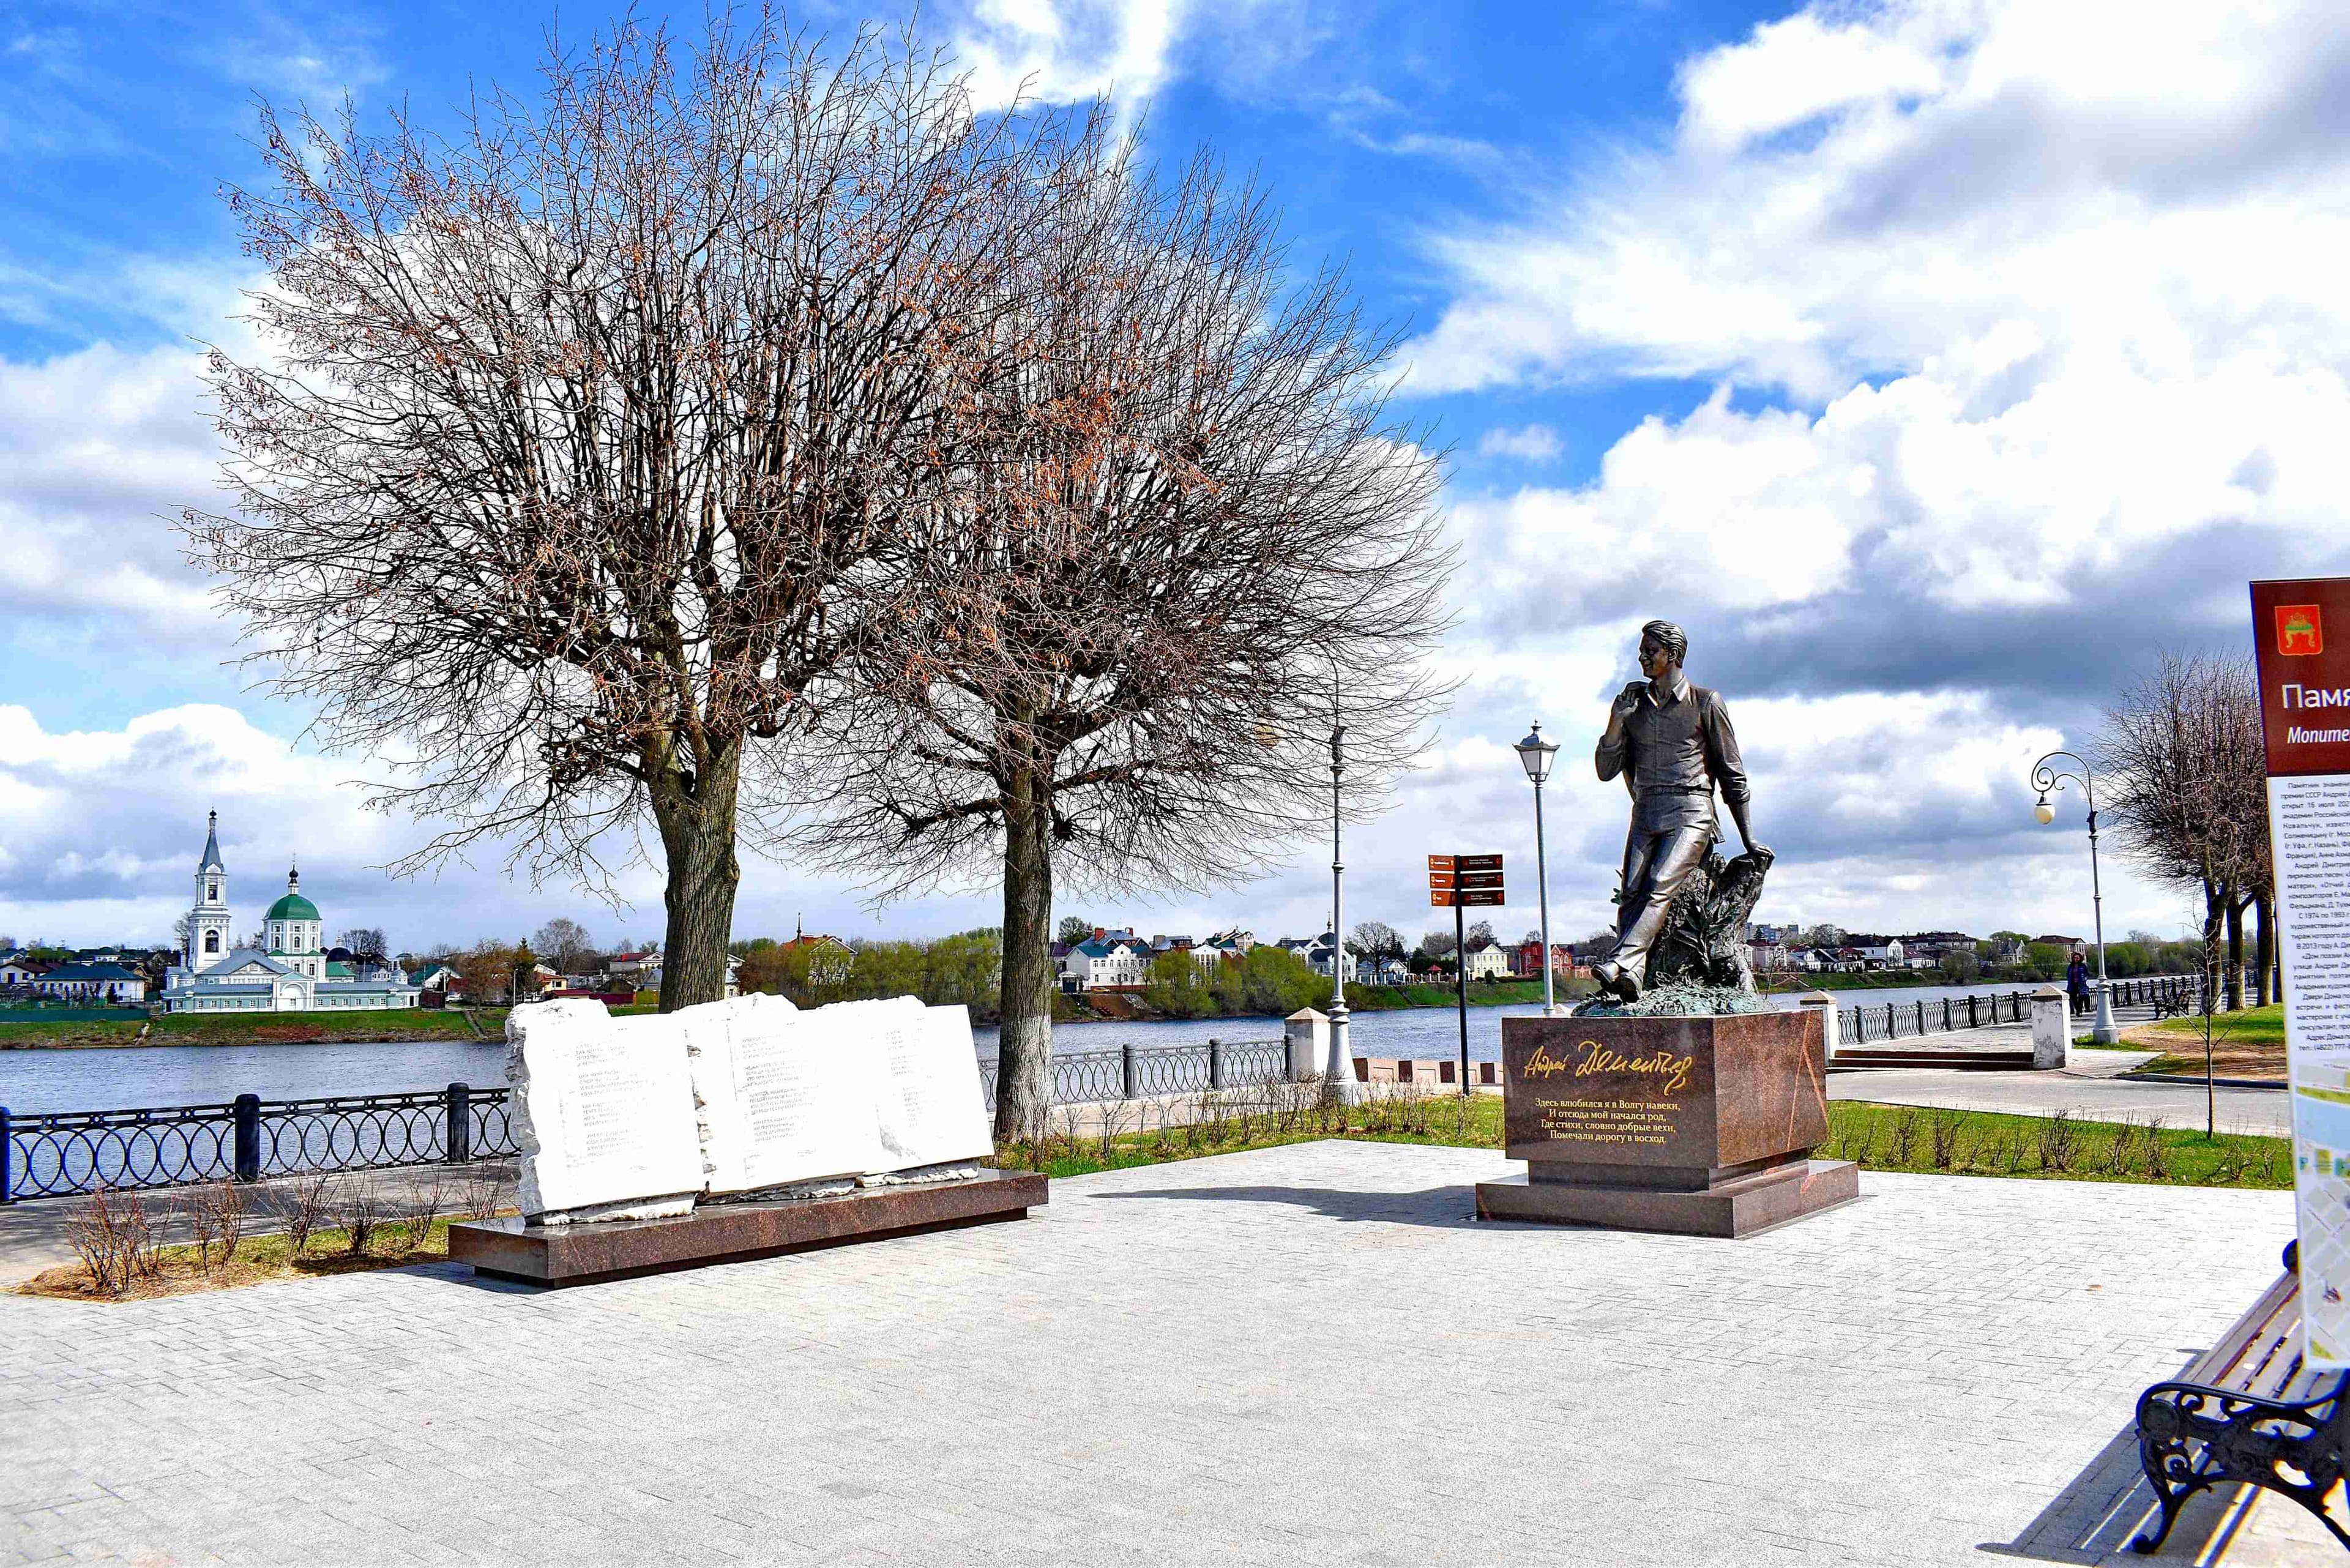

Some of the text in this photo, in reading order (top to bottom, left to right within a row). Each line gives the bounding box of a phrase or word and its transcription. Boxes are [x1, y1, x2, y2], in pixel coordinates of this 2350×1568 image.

[2287, 726, 2350, 744] Monume
[1535, 1097, 1559, 1108] Здесь
[1560, 1099, 1603, 1108] влюбился
[1619, 1100, 1644, 1111] Волгу
[1646, 1102, 1680, 1111] навеки,
[1549, 1108, 1556, 1117] И
[1558, 1111, 1589, 1119] отсюда
[1591, 1110, 1608, 1119] мой
[1647, 1114, 1666, 1122] род,
[1541, 1119, 1554, 1129] Где
[1617, 1122, 1651, 1133] добрые
[1550, 1130, 1594, 1140] Помечали
[1595, 1134, 1625, 1143] дорогу
